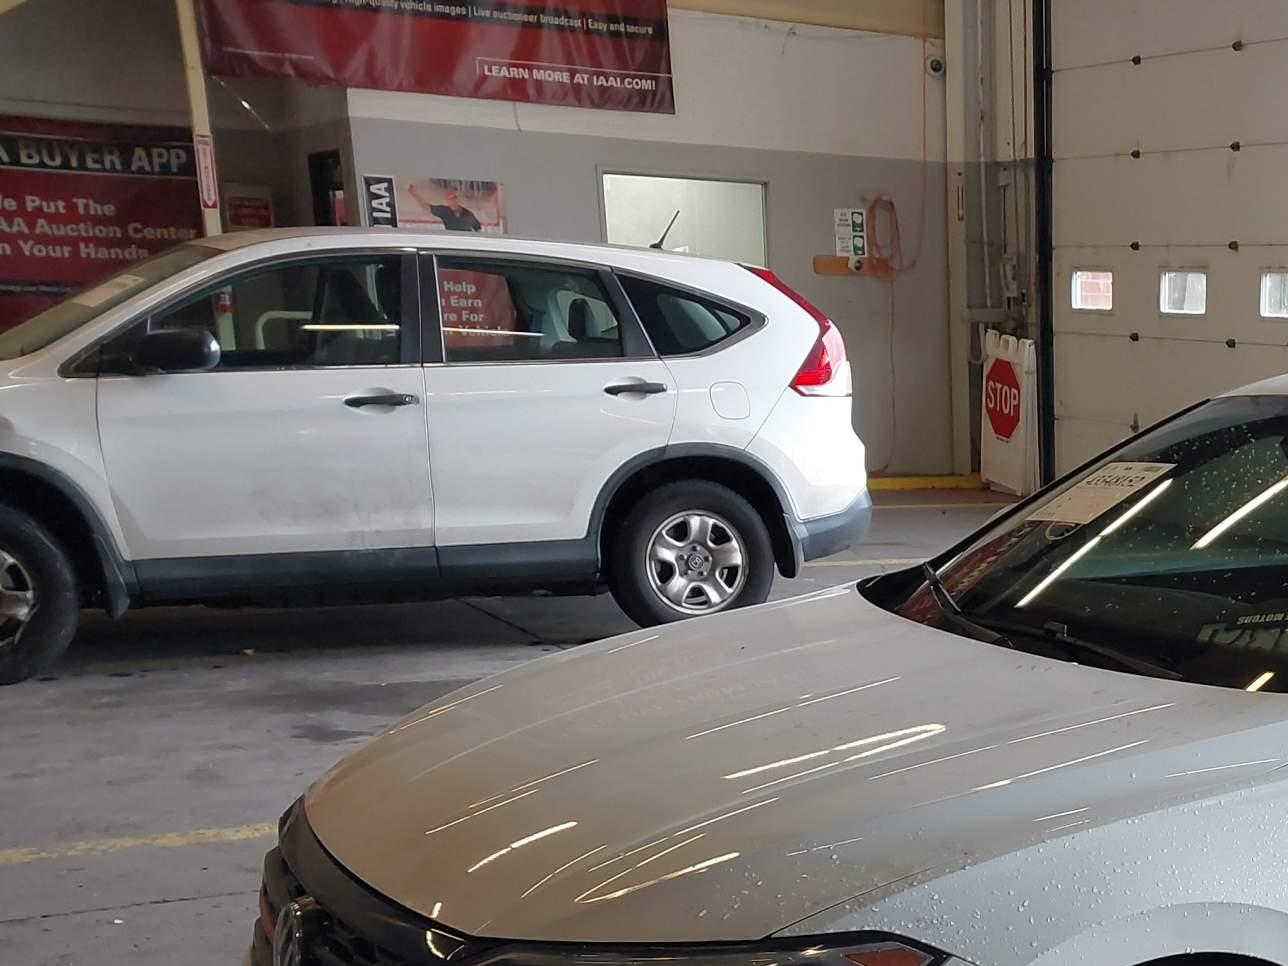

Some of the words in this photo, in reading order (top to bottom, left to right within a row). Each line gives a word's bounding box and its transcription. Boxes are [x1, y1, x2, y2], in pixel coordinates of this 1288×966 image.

[401, 2, 432, 12] vehicle
[433, 4, 466, 16] images
[473, 8, 490, 19] Live
[493, 10, 537, 23] auctioneer
[540, 13, 582, 28] broadcast
[588, 18, 607, 33] Easy
[609, 22, 624, 32] and
[626, 25, 653, 35] secure
[484, 64, 529, 79] LEARN
[532, 68, 570, 84] MORE
[574, 75, 588, 85] AT
[593, 75, 656, 91] IAAI.COM!
[18, 138, 122, 171] BUYER
[130, 146, 187, 172] APP
[25, 195, 66, 214] Put
[72, 198, 116, 216] The
[370, 182, 391, 218] IAA
[35, 218, 121, 239] Auction
[128, 223, 198, 240] Center
[17, 240, 72, 258] Your
[80, 243, 149, 260] Hands
[443, 281, 476, 295] Help
[450, 296, 482, 307] Earn
[462, 310, 484, 322] For
[987, 380, 1019, 417] STOP
[1236, 612, 1284, 625] MOTORS
